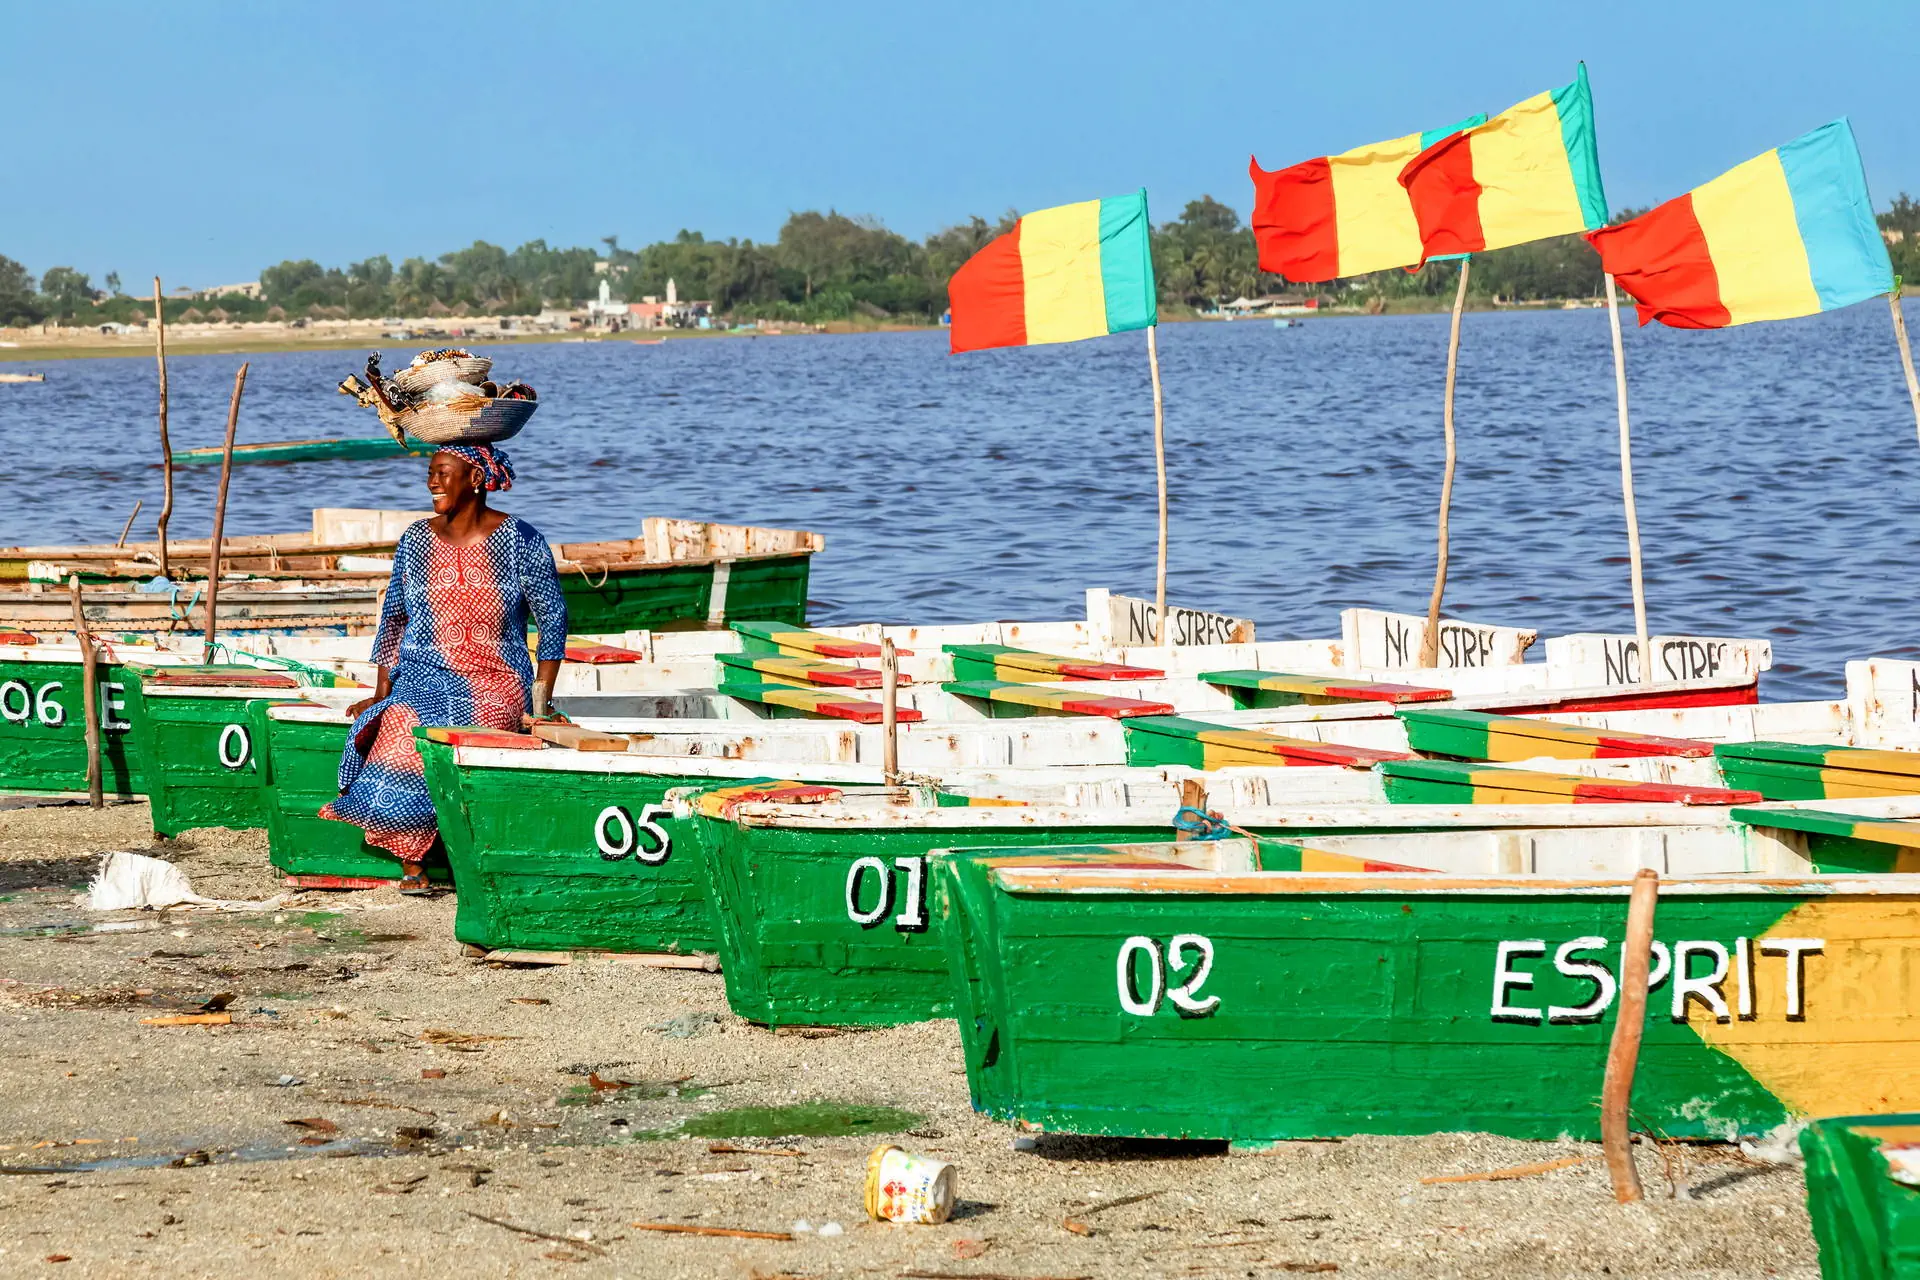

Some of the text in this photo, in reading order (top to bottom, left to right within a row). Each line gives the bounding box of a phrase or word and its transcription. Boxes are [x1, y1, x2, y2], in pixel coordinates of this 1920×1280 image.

[0, 678, 66, 728] 06
[594, 804, 673, 865] 05
[846, 856, 928, 932] 01
[1116, 934, 1221, 1019] 02
[1490, 937, 1826, 1026] ESPRIT
